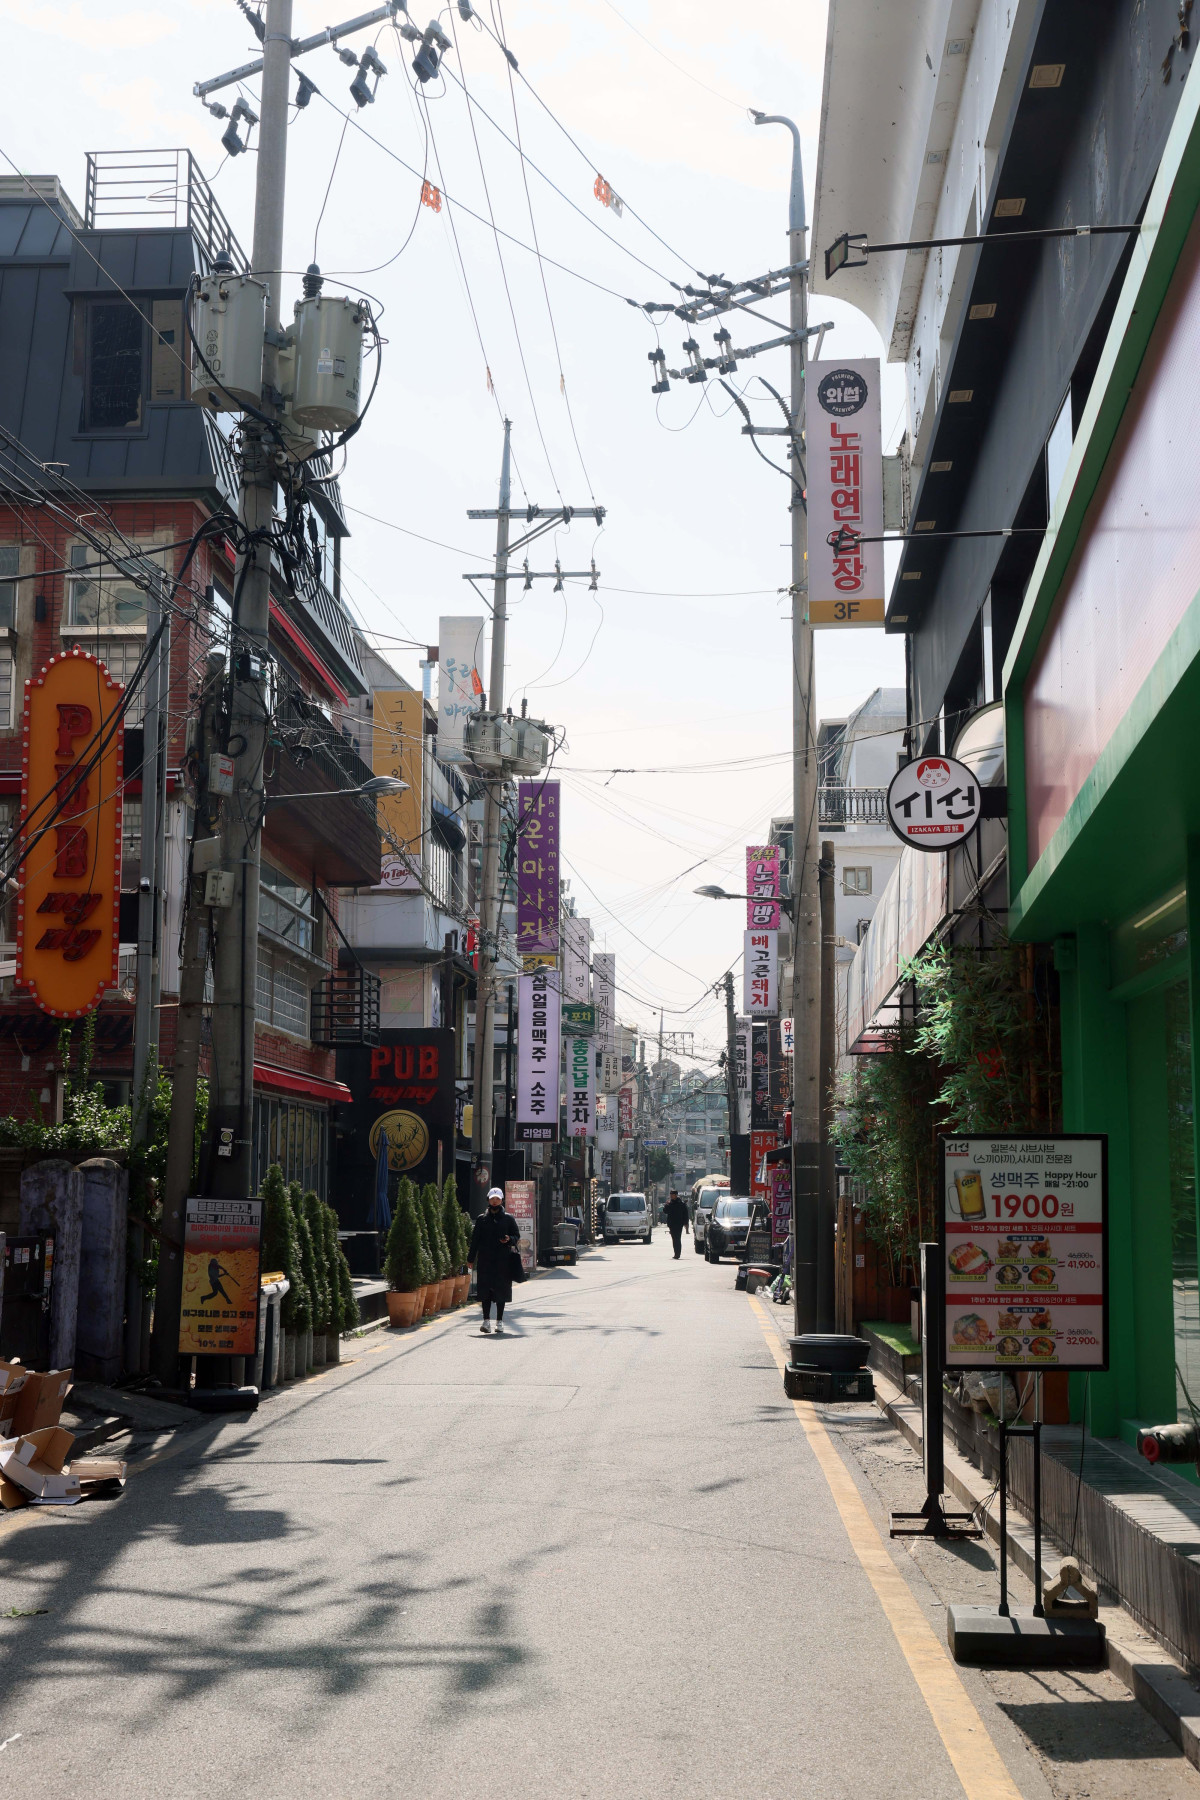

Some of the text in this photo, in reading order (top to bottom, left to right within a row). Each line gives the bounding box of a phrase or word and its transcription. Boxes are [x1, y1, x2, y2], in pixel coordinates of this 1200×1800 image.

[831, 373, 855, 381] PREMIUM
[826, 386, 859, 404] 와썹
[834, 601, 860, 620] 3F
[53, 703, 92, 878] PUB
[894, 786, 975, 820] 시선
[521, 794, 545, 940] 라온마사지
[753, 864, 775, 924] 노래방
[35, 892, 102, 925] my
[35, 928, 102, 962] my
[571, 1012, 592, 1022] 포차
[369, 1045, 439, 1080] PUB
[572, 1091, 590, 1123] 포차
[574, 1127, 587, 1136] 2층
[753, 1136, 775, 1147] 리치
[946, 1143, 969, 1152] 시선
[991, 1144, 1055, 1154] 일본식 샤브샤브
[1046, 1154, 1072, 1164] 전문점
[962, 1176, 977, 1187] Cass
[990, 1172, 1040, 1188] 생맥주
[1044, 1172, 1073, 1180] Happy
[1044, 1180, 1060, 1188] 매일
[189, 1213, 215, 1223] 맥주는
[216, 1214, 250, 1224] 시원하게
[199, 1340, 216, 1348] 10%
